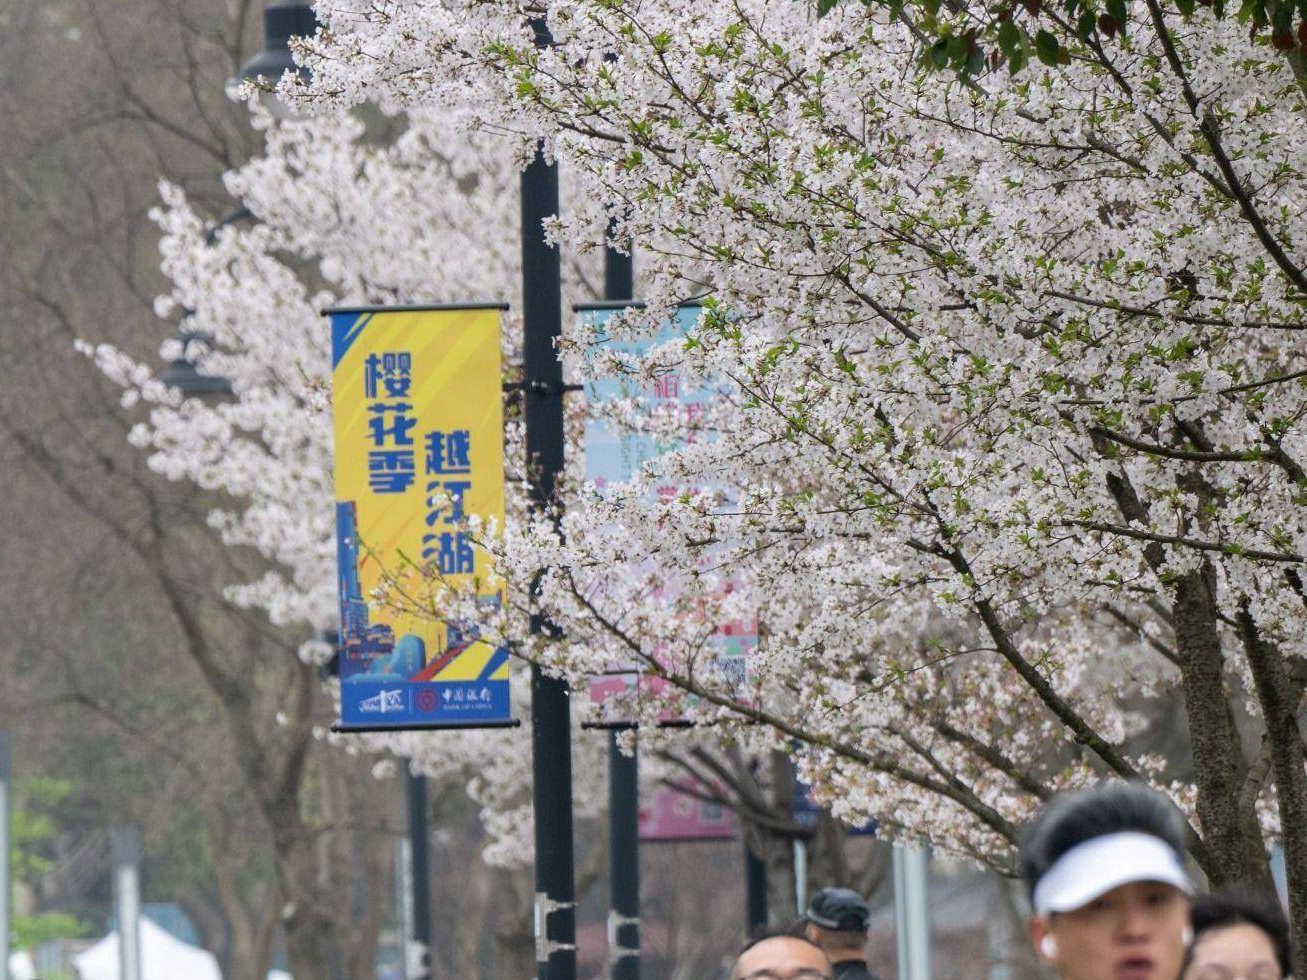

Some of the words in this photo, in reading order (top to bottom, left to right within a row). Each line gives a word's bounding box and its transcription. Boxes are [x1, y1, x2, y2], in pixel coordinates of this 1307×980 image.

[364, 351, 417, 494] 樱花季
[422, 429, 475, 575] 越江湖
